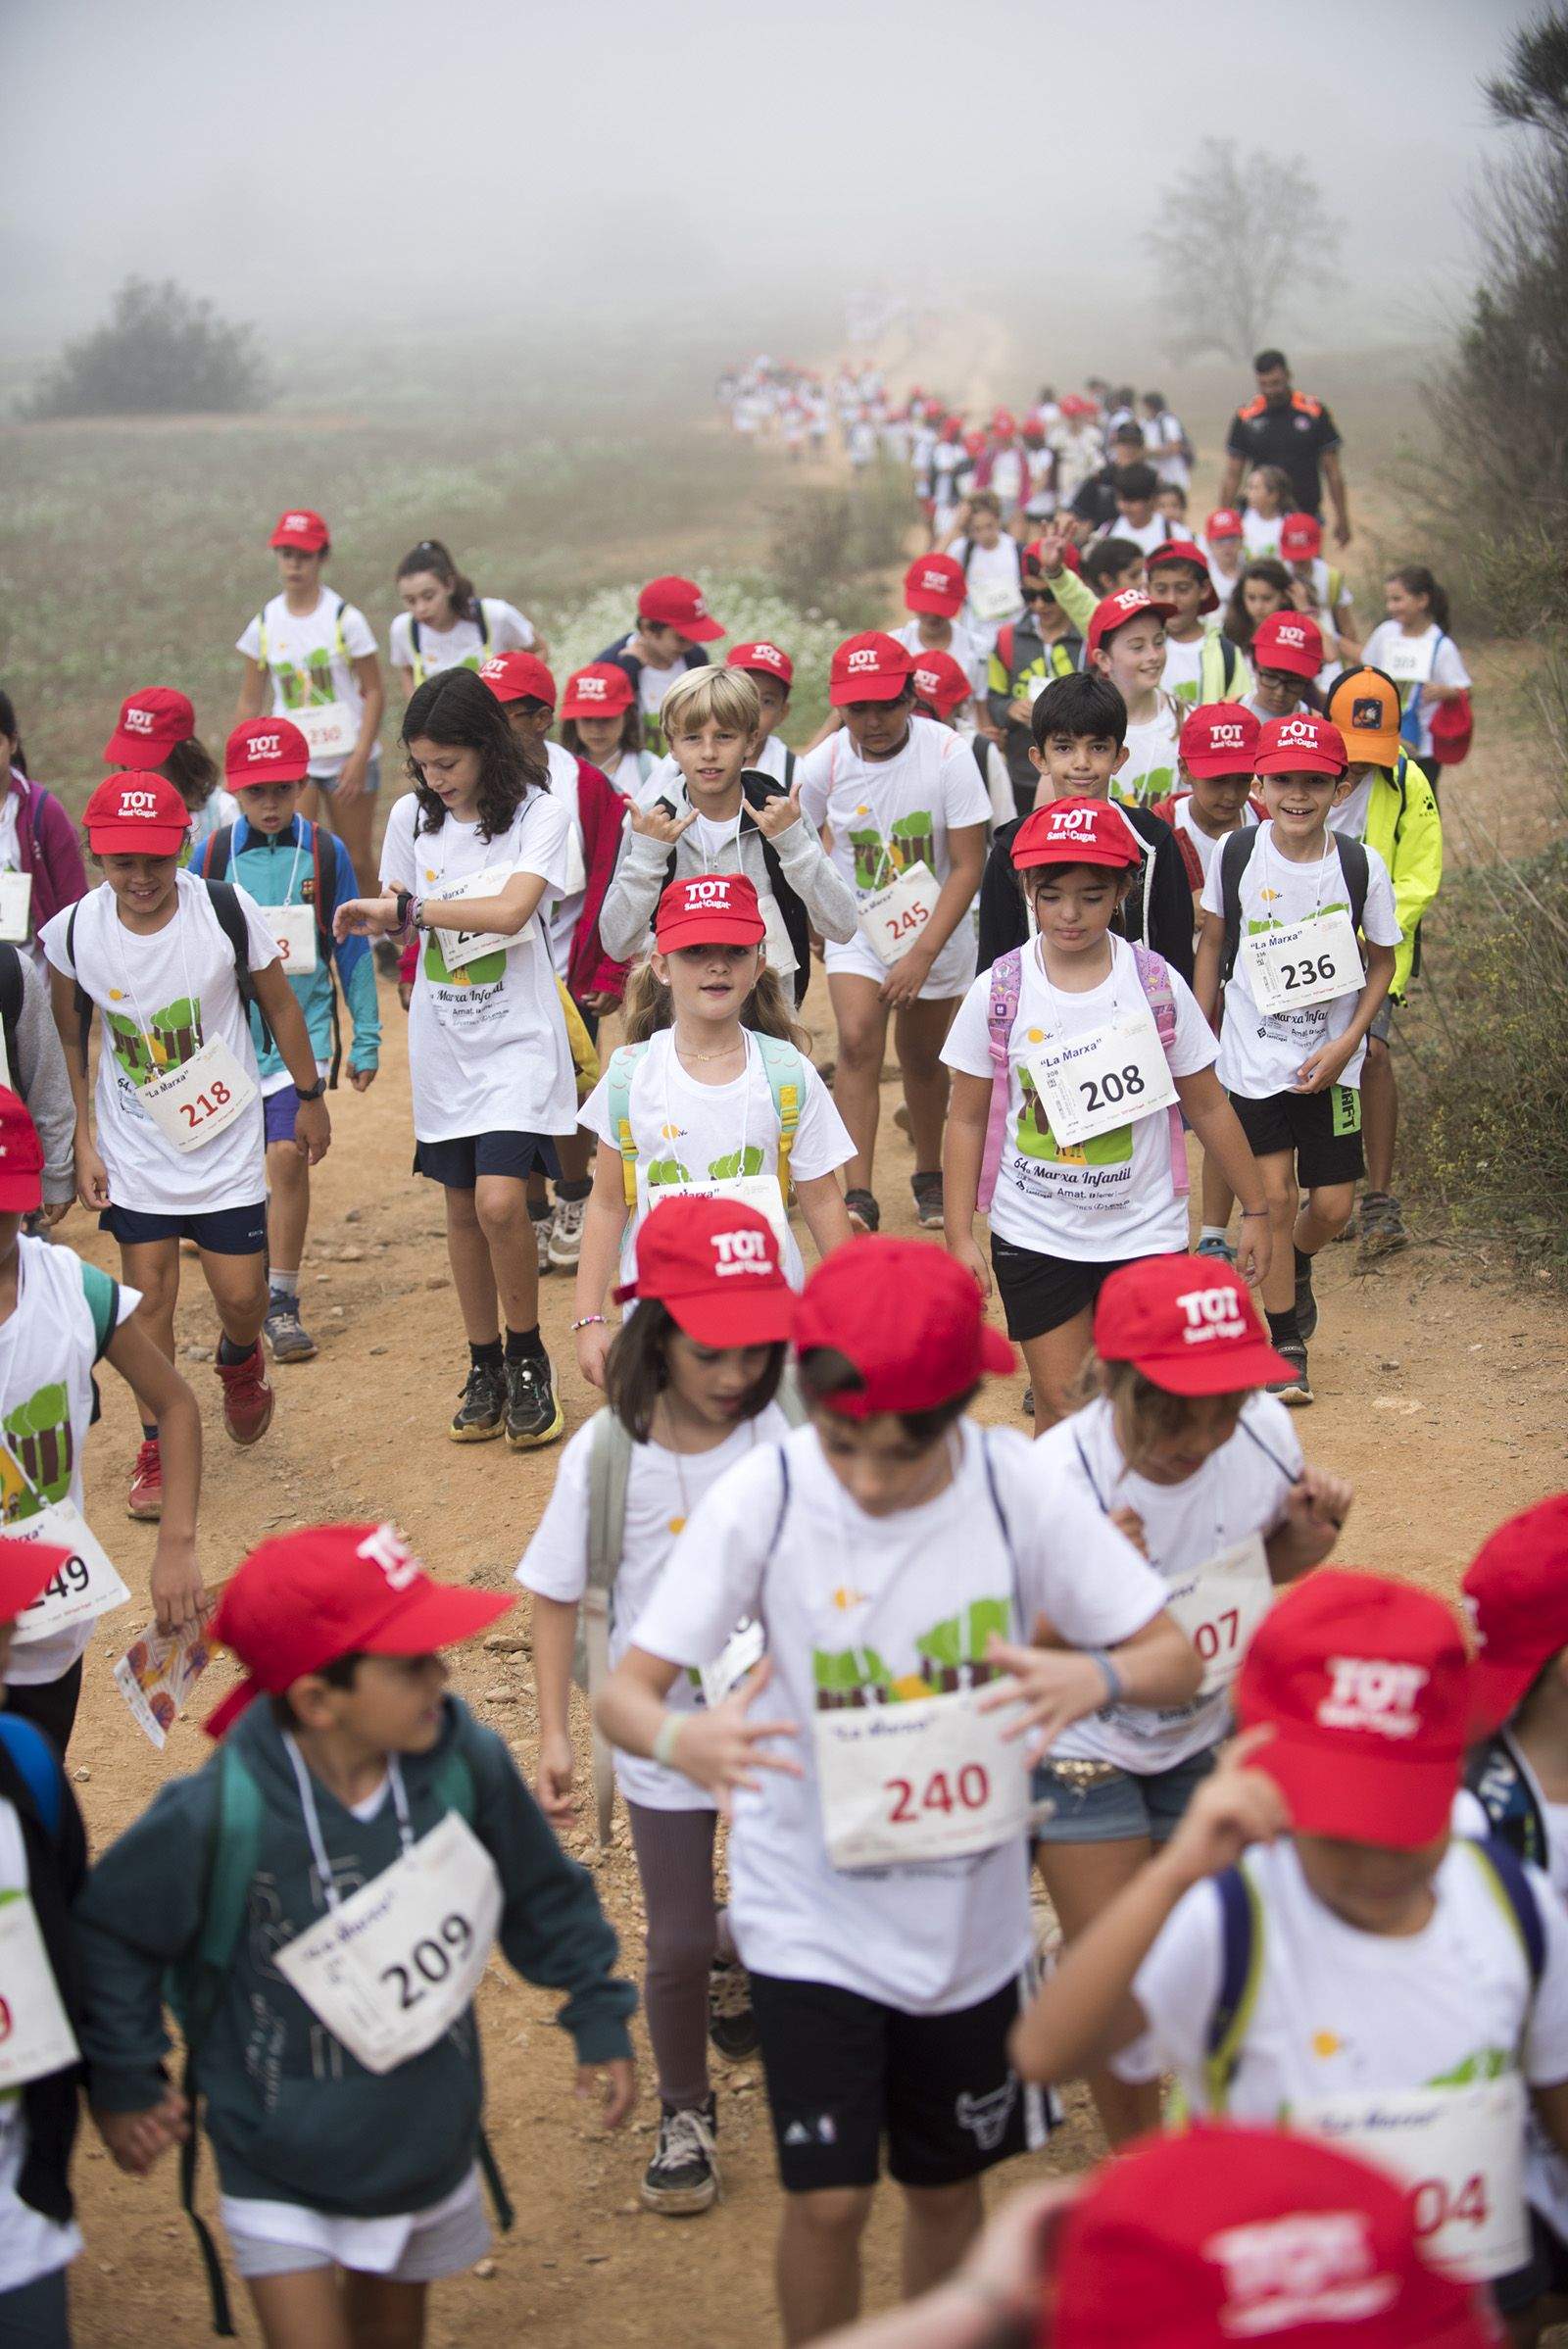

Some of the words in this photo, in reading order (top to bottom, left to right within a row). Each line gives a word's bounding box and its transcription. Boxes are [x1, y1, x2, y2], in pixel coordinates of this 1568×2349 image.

[848, 650, 877, 665] TOT
[127, 709, 154, 727] TOT
[1280, 720, 1318, 739] TOT
[247, 735, 280, 754] TOT
[1210, 724, 1244, 741] TOT
[121, 791, 157, 808] TOT
[1052, 808, 1098, 831] TOT
[1047, 830, 1067, 841] Sant
[1070, 830, 1097, 843] Cugat
[685, 881, 730, 902] TOT
[684, 901, 703, 911] Sant
[706, 900, 731, 909] Cugat
[886, 901, 929, 940] 245
[1281, 954, 1336, 991] 236
[1079, 1064, 1146, 1112] 208
[179, 1080, 231, 1128] 218
[1033, 1165, 1078, 1184] Marxa
[1081, 1167, 1132, 1188] Infantil
[710, 1230, 766, 1262] TOT
[1176, 1286, 1240, 1326] TOT
[1194, 1606, 1240, 1661] 07
[1325, 1656, 1431, 1711] TOT
[884, 1763, 989, 1824] 240
[380, 1913, 473, 2011] 209
[1412, 2174, 1489, 2237] 04
